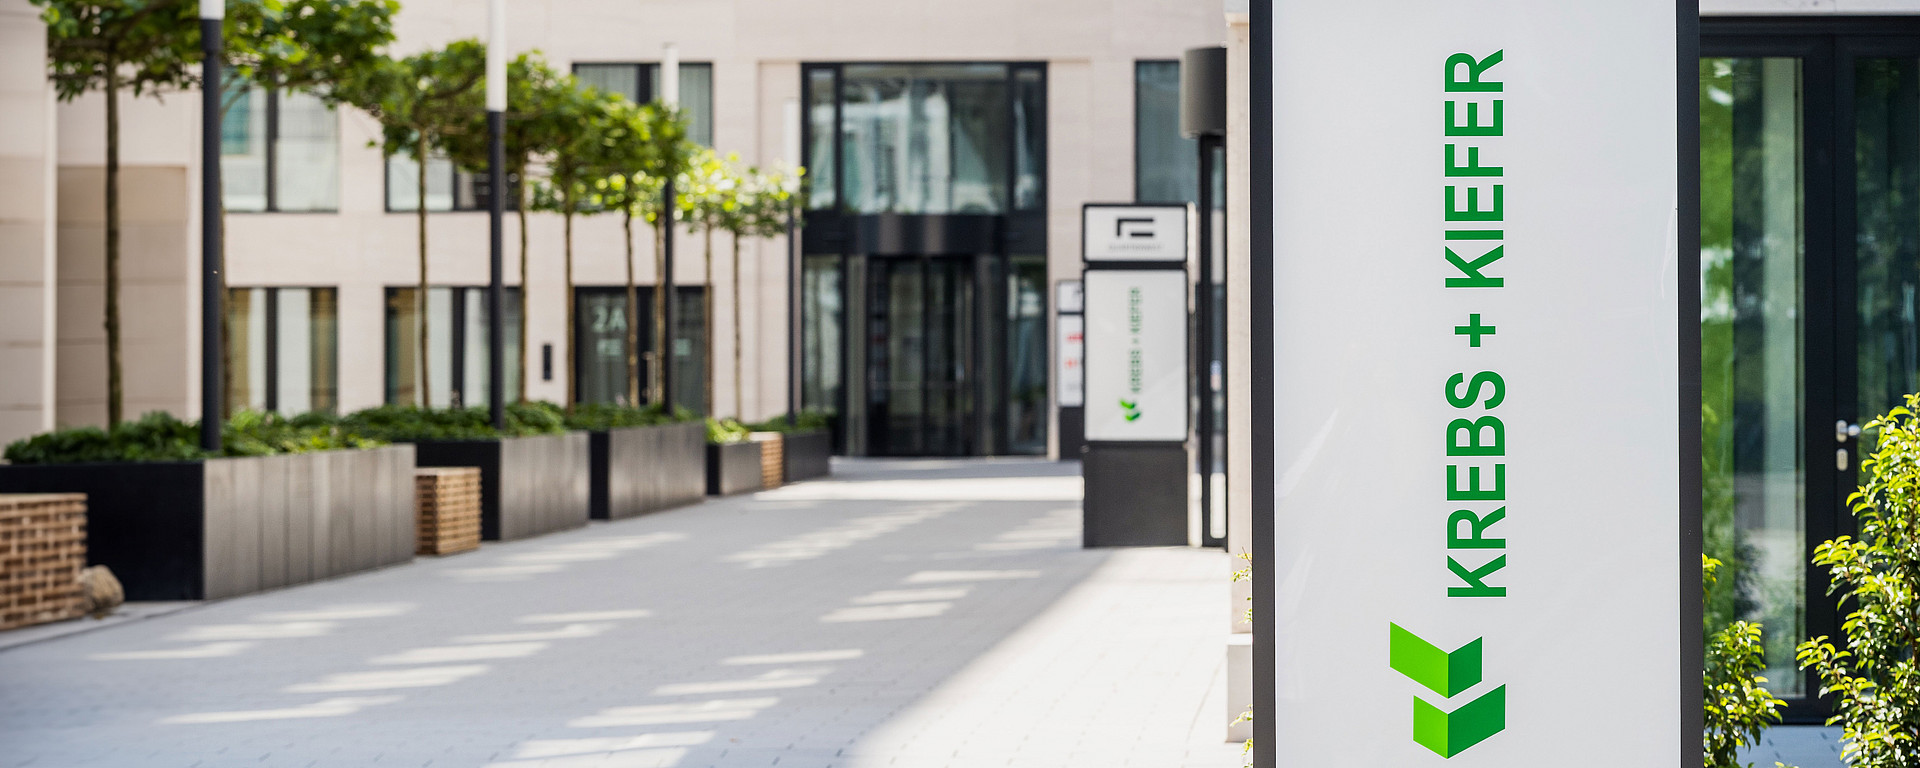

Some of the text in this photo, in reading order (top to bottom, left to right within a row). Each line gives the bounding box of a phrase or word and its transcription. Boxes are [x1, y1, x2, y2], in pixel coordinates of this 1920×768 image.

[592, 306, 627, 333] 2A
[1444, 48, 1507, 598] KREBS + KIEFER
